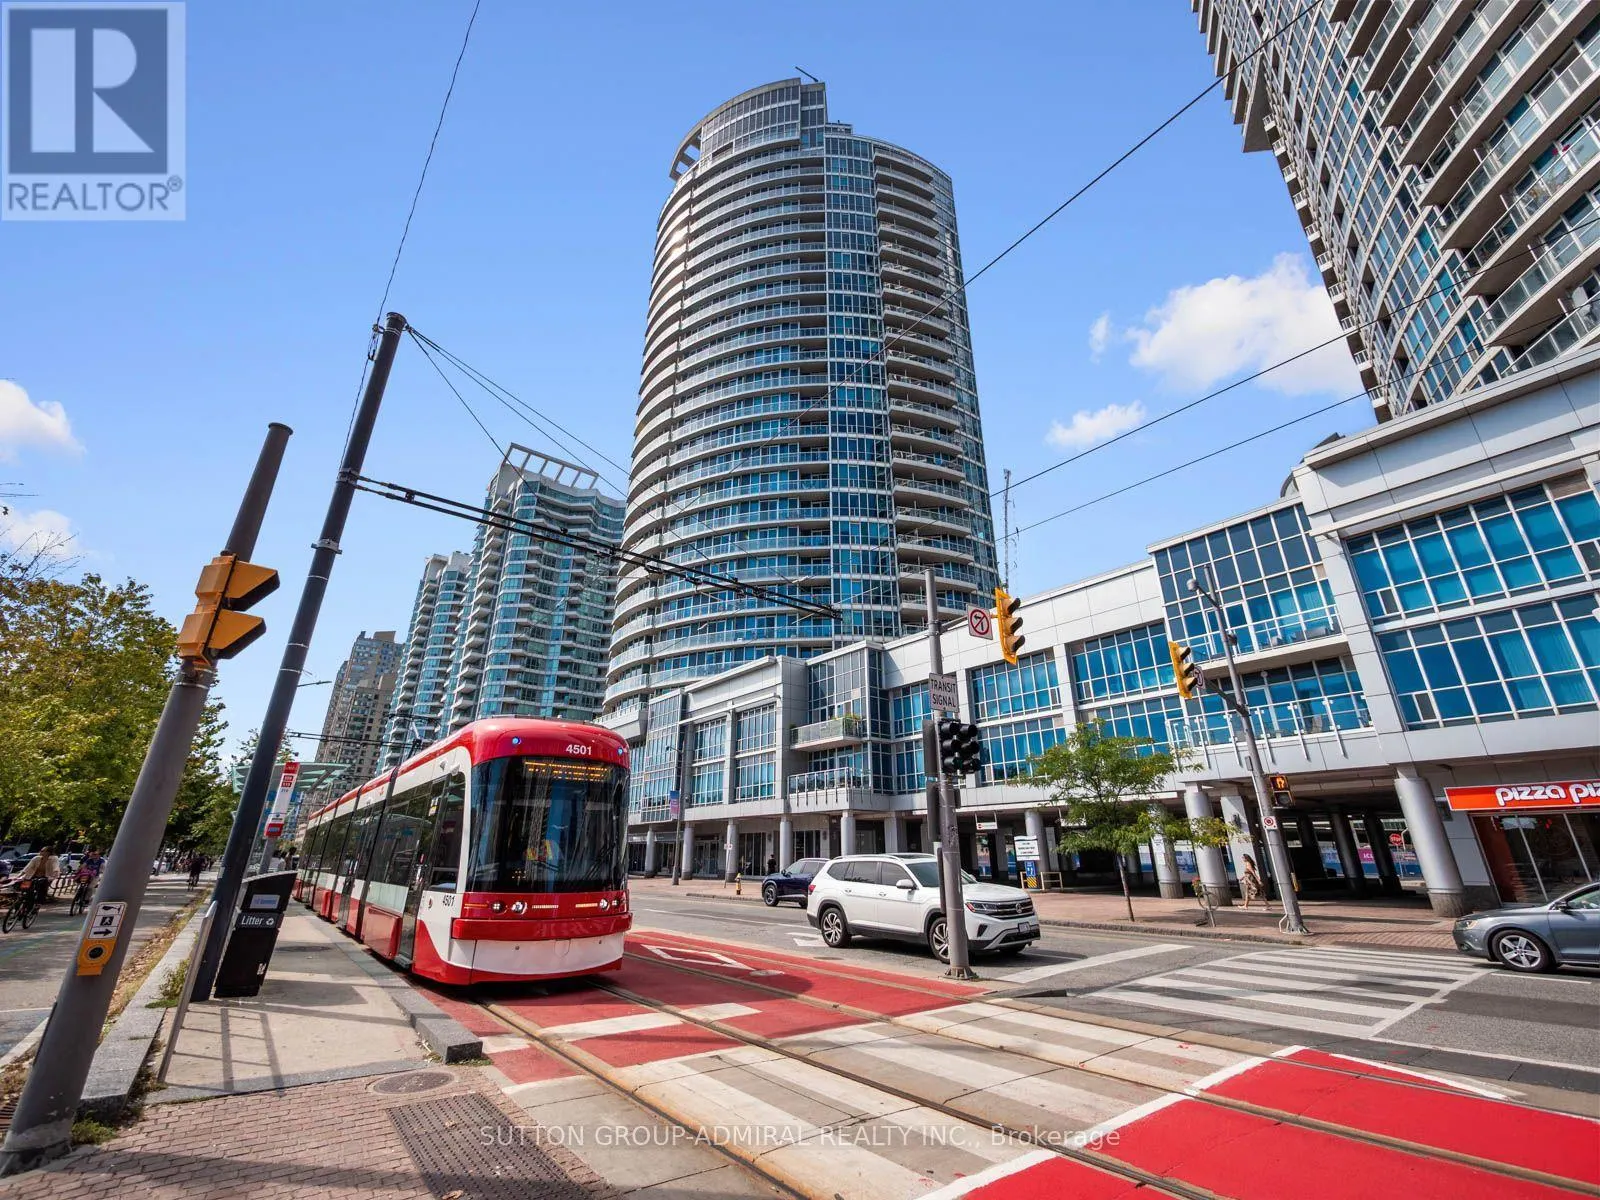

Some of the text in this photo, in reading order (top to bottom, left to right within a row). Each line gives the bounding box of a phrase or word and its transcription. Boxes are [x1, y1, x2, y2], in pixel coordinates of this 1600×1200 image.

[930, 679, 957, 694] TRANSIT
[932, 693, 957, 708] SIGNAL
[565, 743, 593, 756] 4501
[1495, 784, 1567, 807] pizza
[241, 915, 264, 926] Litter
